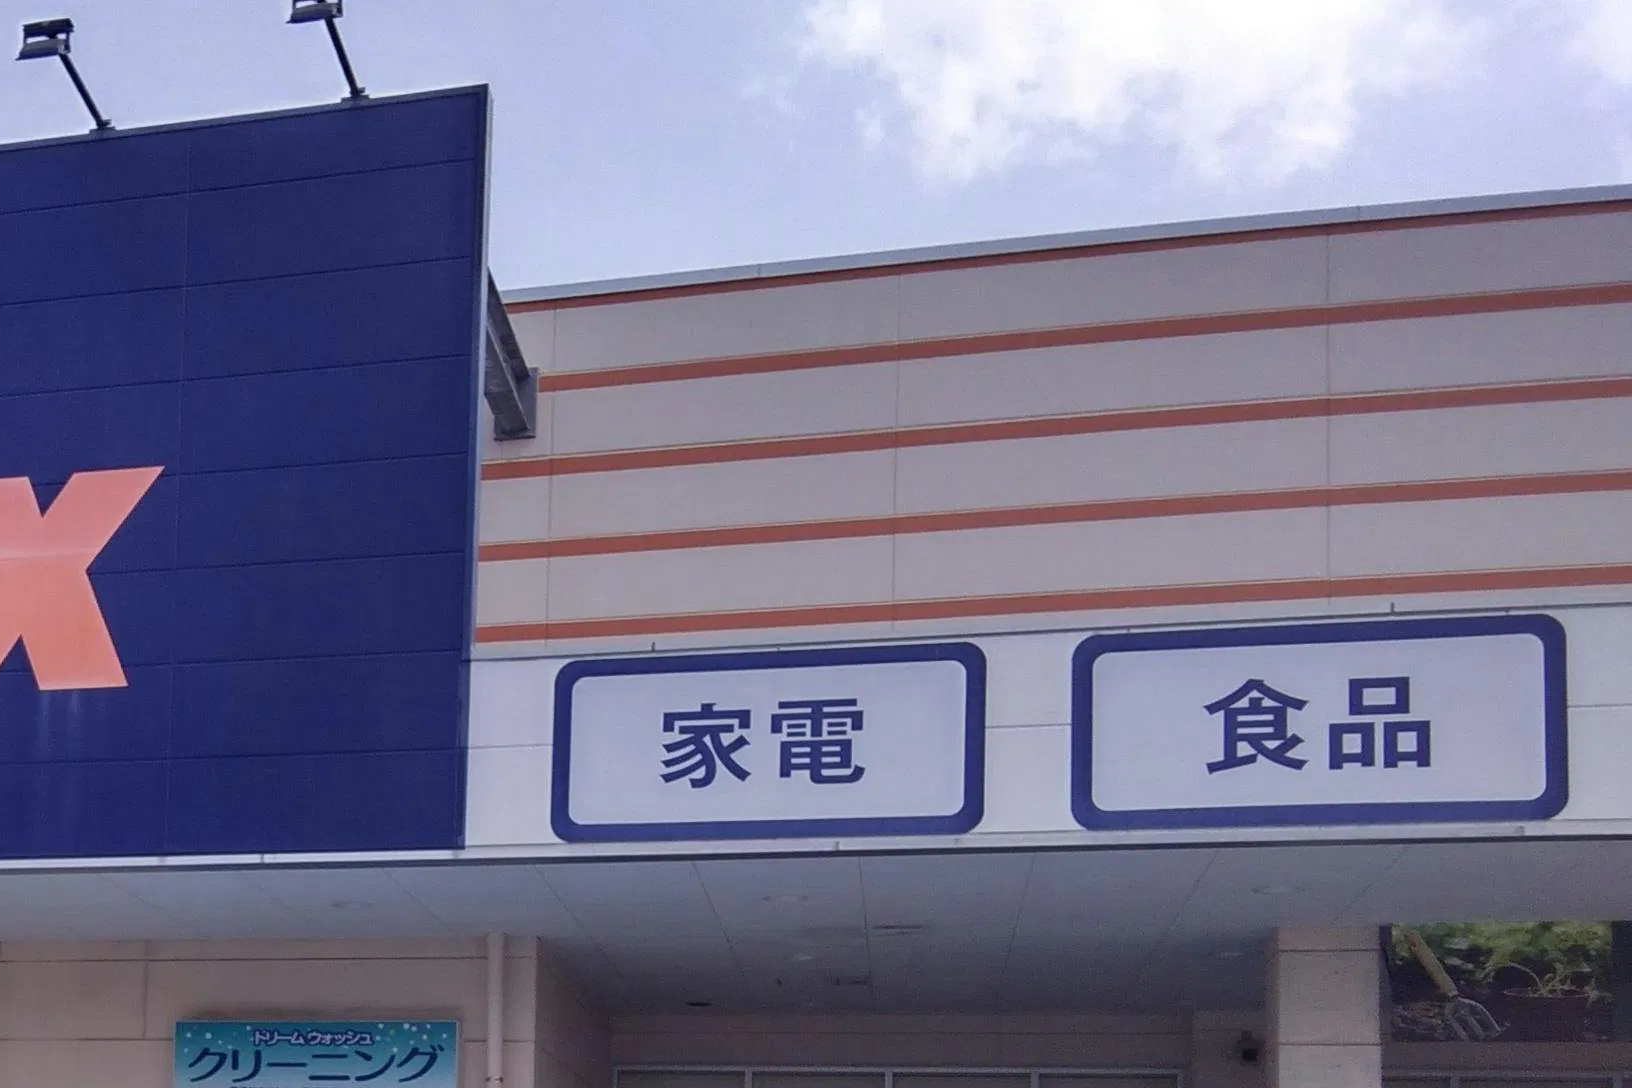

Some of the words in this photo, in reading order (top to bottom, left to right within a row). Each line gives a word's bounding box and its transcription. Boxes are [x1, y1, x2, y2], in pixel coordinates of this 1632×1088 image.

[660, 696, 866, 787] 家電
[1205, 676, 1433, 775] 食品
[188, 1043, 444, 1083] クリーニング
